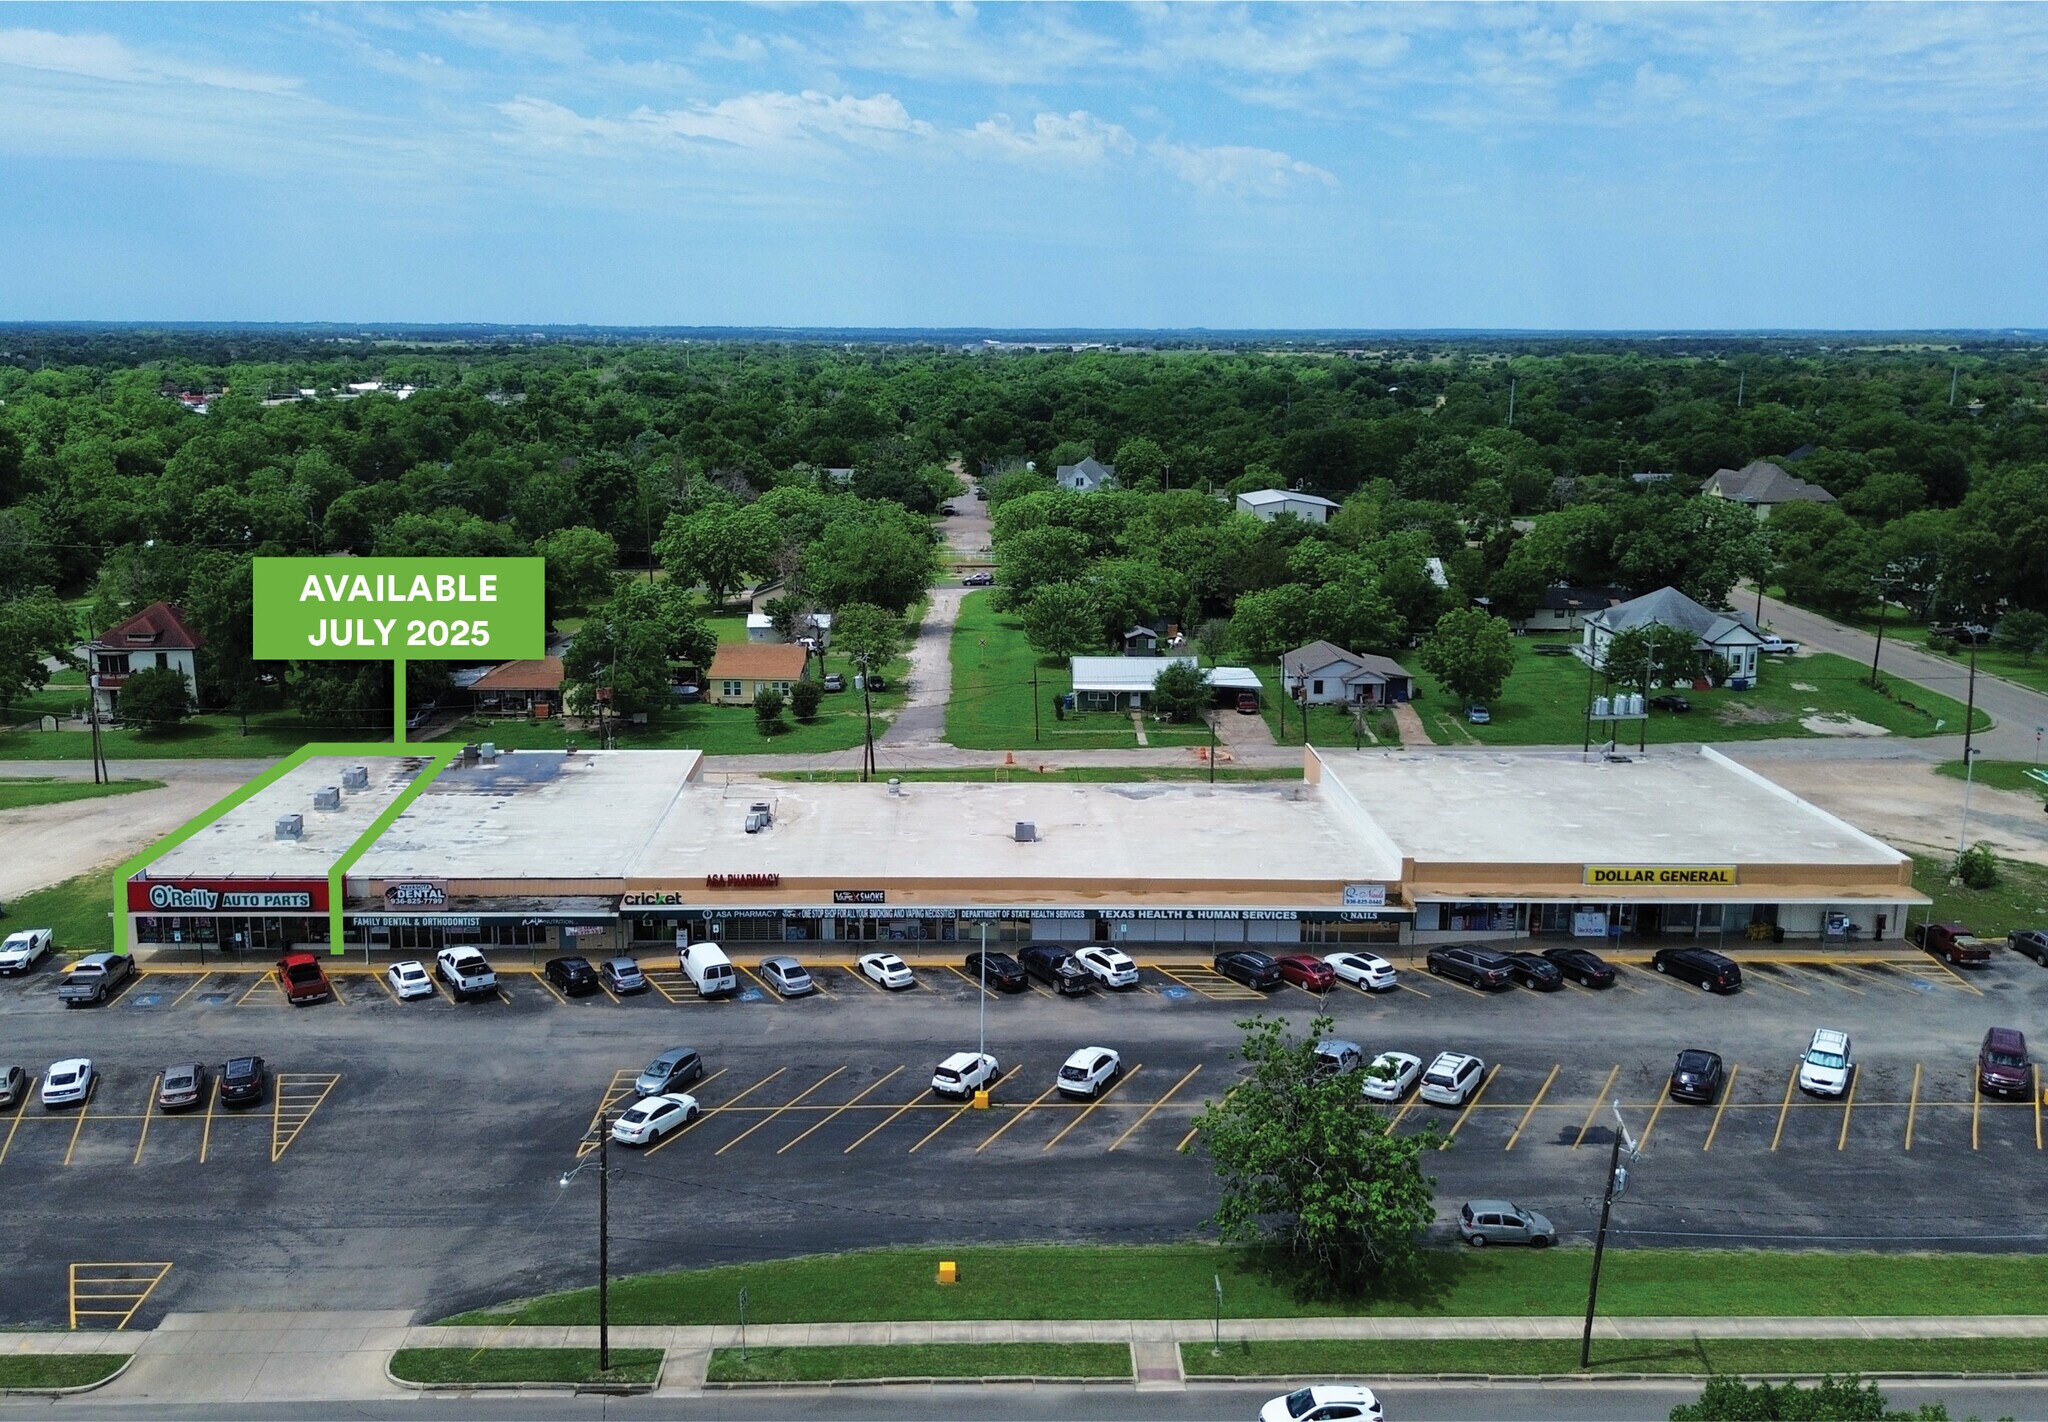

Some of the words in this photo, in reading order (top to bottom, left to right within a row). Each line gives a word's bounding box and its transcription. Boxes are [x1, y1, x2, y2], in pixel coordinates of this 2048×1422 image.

[706, 874, 723, 887] ASA
[727, 874, 779, 887] PHARMACY
[1595, 870, 1654, 882] DOLLAR
[1660, 870, 1728, 882] GENERAL
[151, 885, 218, 910] O'Reilly
[397, 890, 445, 898] DENTAL
[624, 892, 683, 905] cricket
[860, 892, 884, 902] SMOKE
[223, 895, 259, 906] AUTO
[265, 895, 309, 906] PARTS
[801, 909, 812, 918] ONE
[812, 909, 824, 918] STOP
[824, 909, 837, 918] SHOP
[837, 909, 847, 918] FOR
[847, 909, 856, 918] ALL
[856, 909, 868, 918] YOUR
[869, 909, 893, 919] SMOKING
[894, 909, 905, 919] AND
[905, 909, 924, 919] VAPING
[961, 910, 1001, 918] DEPARTMENT
[1002, 910, 1010, 918] OF
[1011, 910, 1030, 918] STATE
[1031, 910, 1054, 918] HEALTH
[1055, 910, 1085, 918] SERVICES
[1099, 910, 1136, 919] TEXAS
[1138, 910, 1182, 919] HEALTH
[1186, 910, 1195, 919] &
[1197, 910, 1239, 919] HUMAN
[1242, 911, 1298, 920] SERVICES
[1340, 912, 1352, 922] Q
[353, 918, 381, 926] FAMILY
[383, 918, 412, 926] DENTAL
[414, 918, 420, 926] &
[422, 918, 480, 926] ORTHODONTIST
